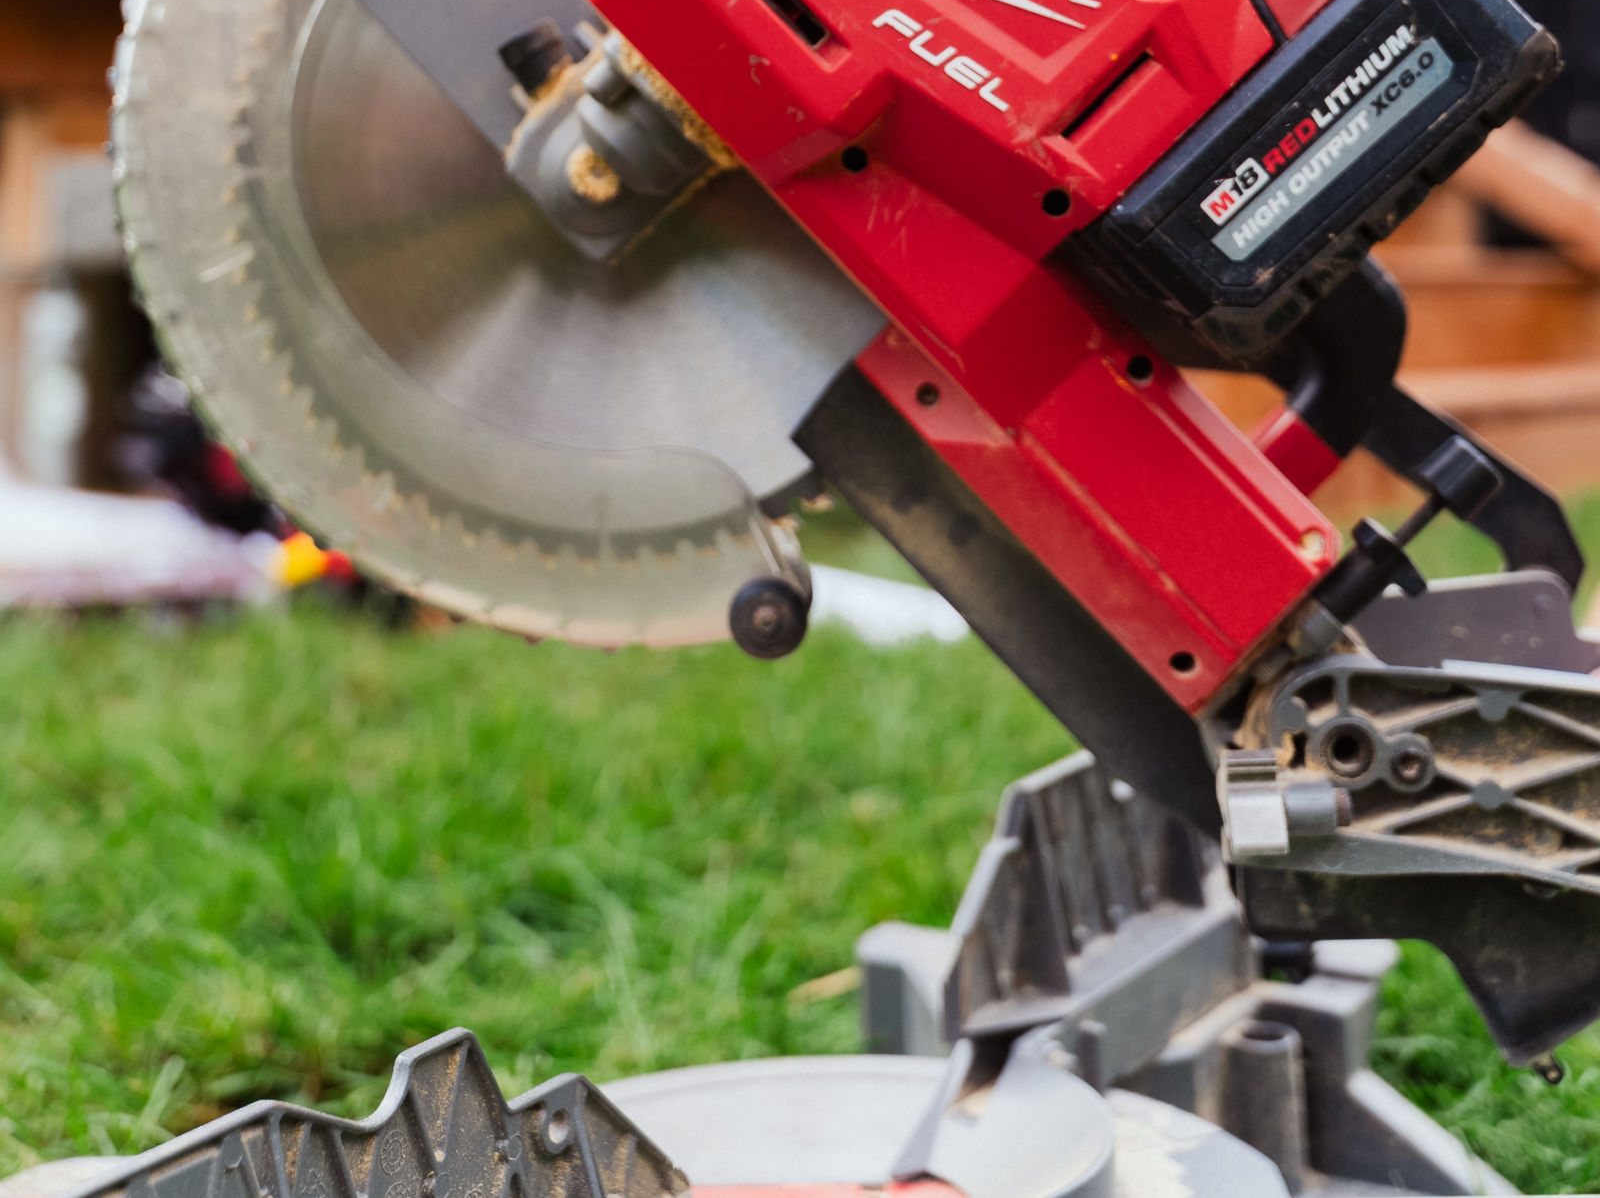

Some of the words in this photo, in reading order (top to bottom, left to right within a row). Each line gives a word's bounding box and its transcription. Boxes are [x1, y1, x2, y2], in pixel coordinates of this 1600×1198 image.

[872, 9, 1011, 112] FUEL
[1208, 166, 1260, 218] M18
[1262, 25, 1413, 174] REDLITHIUM
[1231, 191, 1291, 249] HIGH
[1287, 110, 1371, 196] OUTPUT
[1370, 51, 1434, 117] XC6.0
